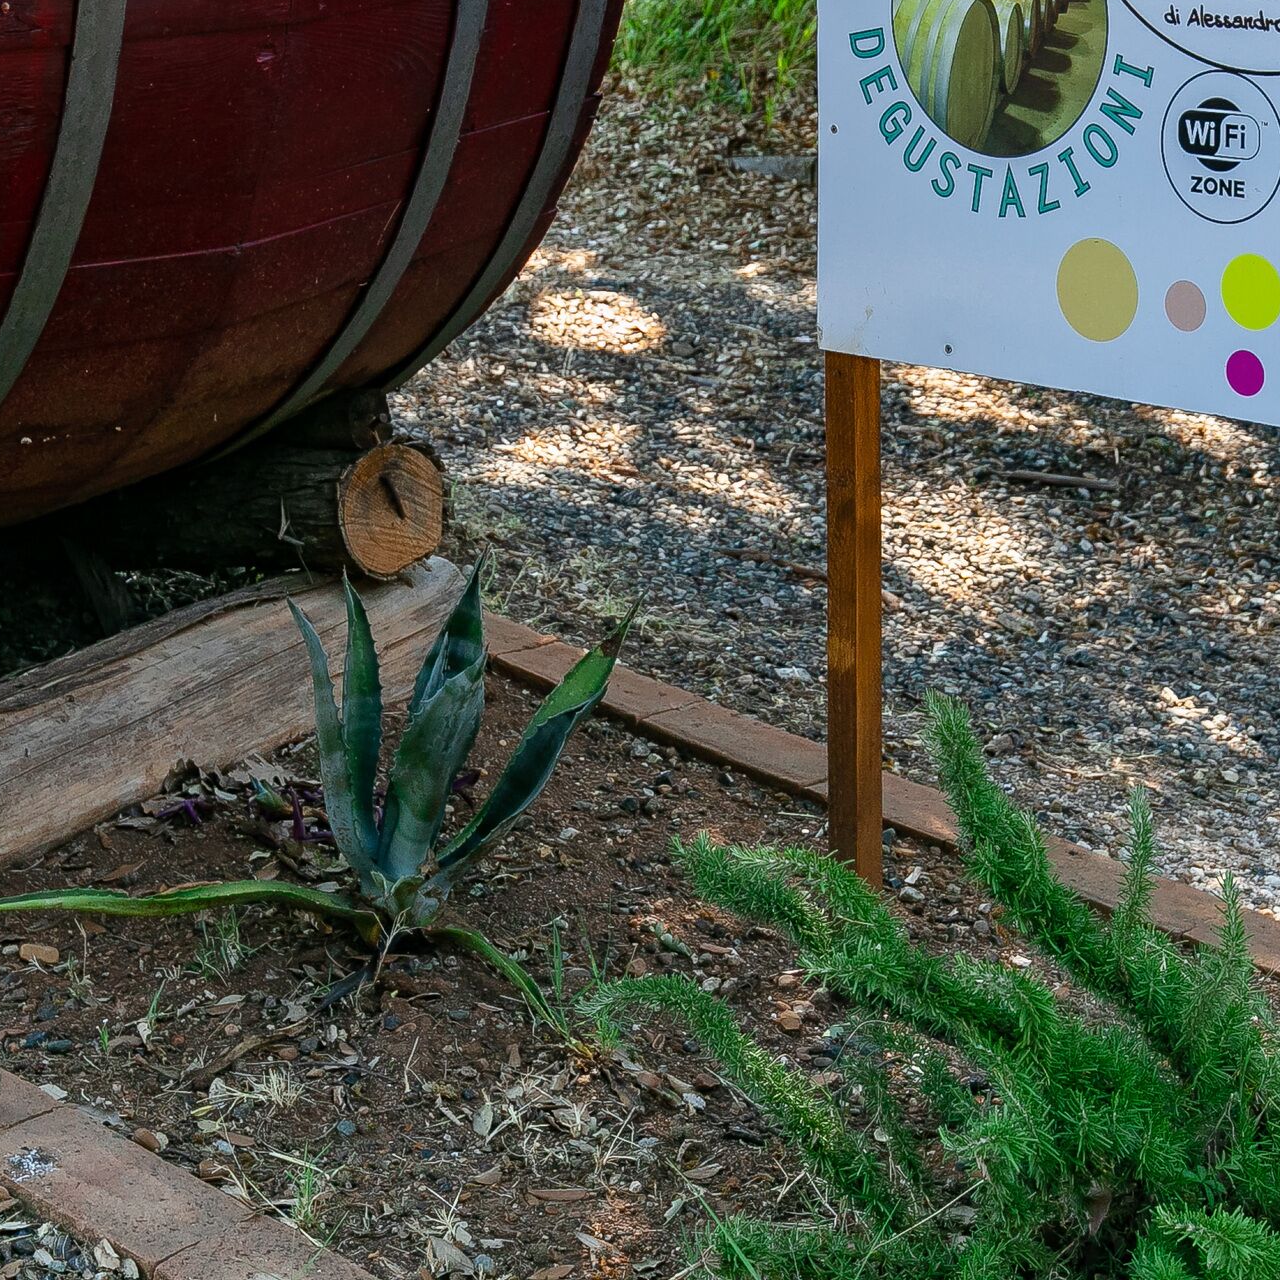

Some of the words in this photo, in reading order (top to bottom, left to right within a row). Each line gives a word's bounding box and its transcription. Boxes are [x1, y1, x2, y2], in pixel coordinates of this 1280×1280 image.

[1163, 5, 1181, 26] di
[849, 26, 1155, 219] DEGUSTAZIONI
[1190, 176, 1245, 199] ZONE
